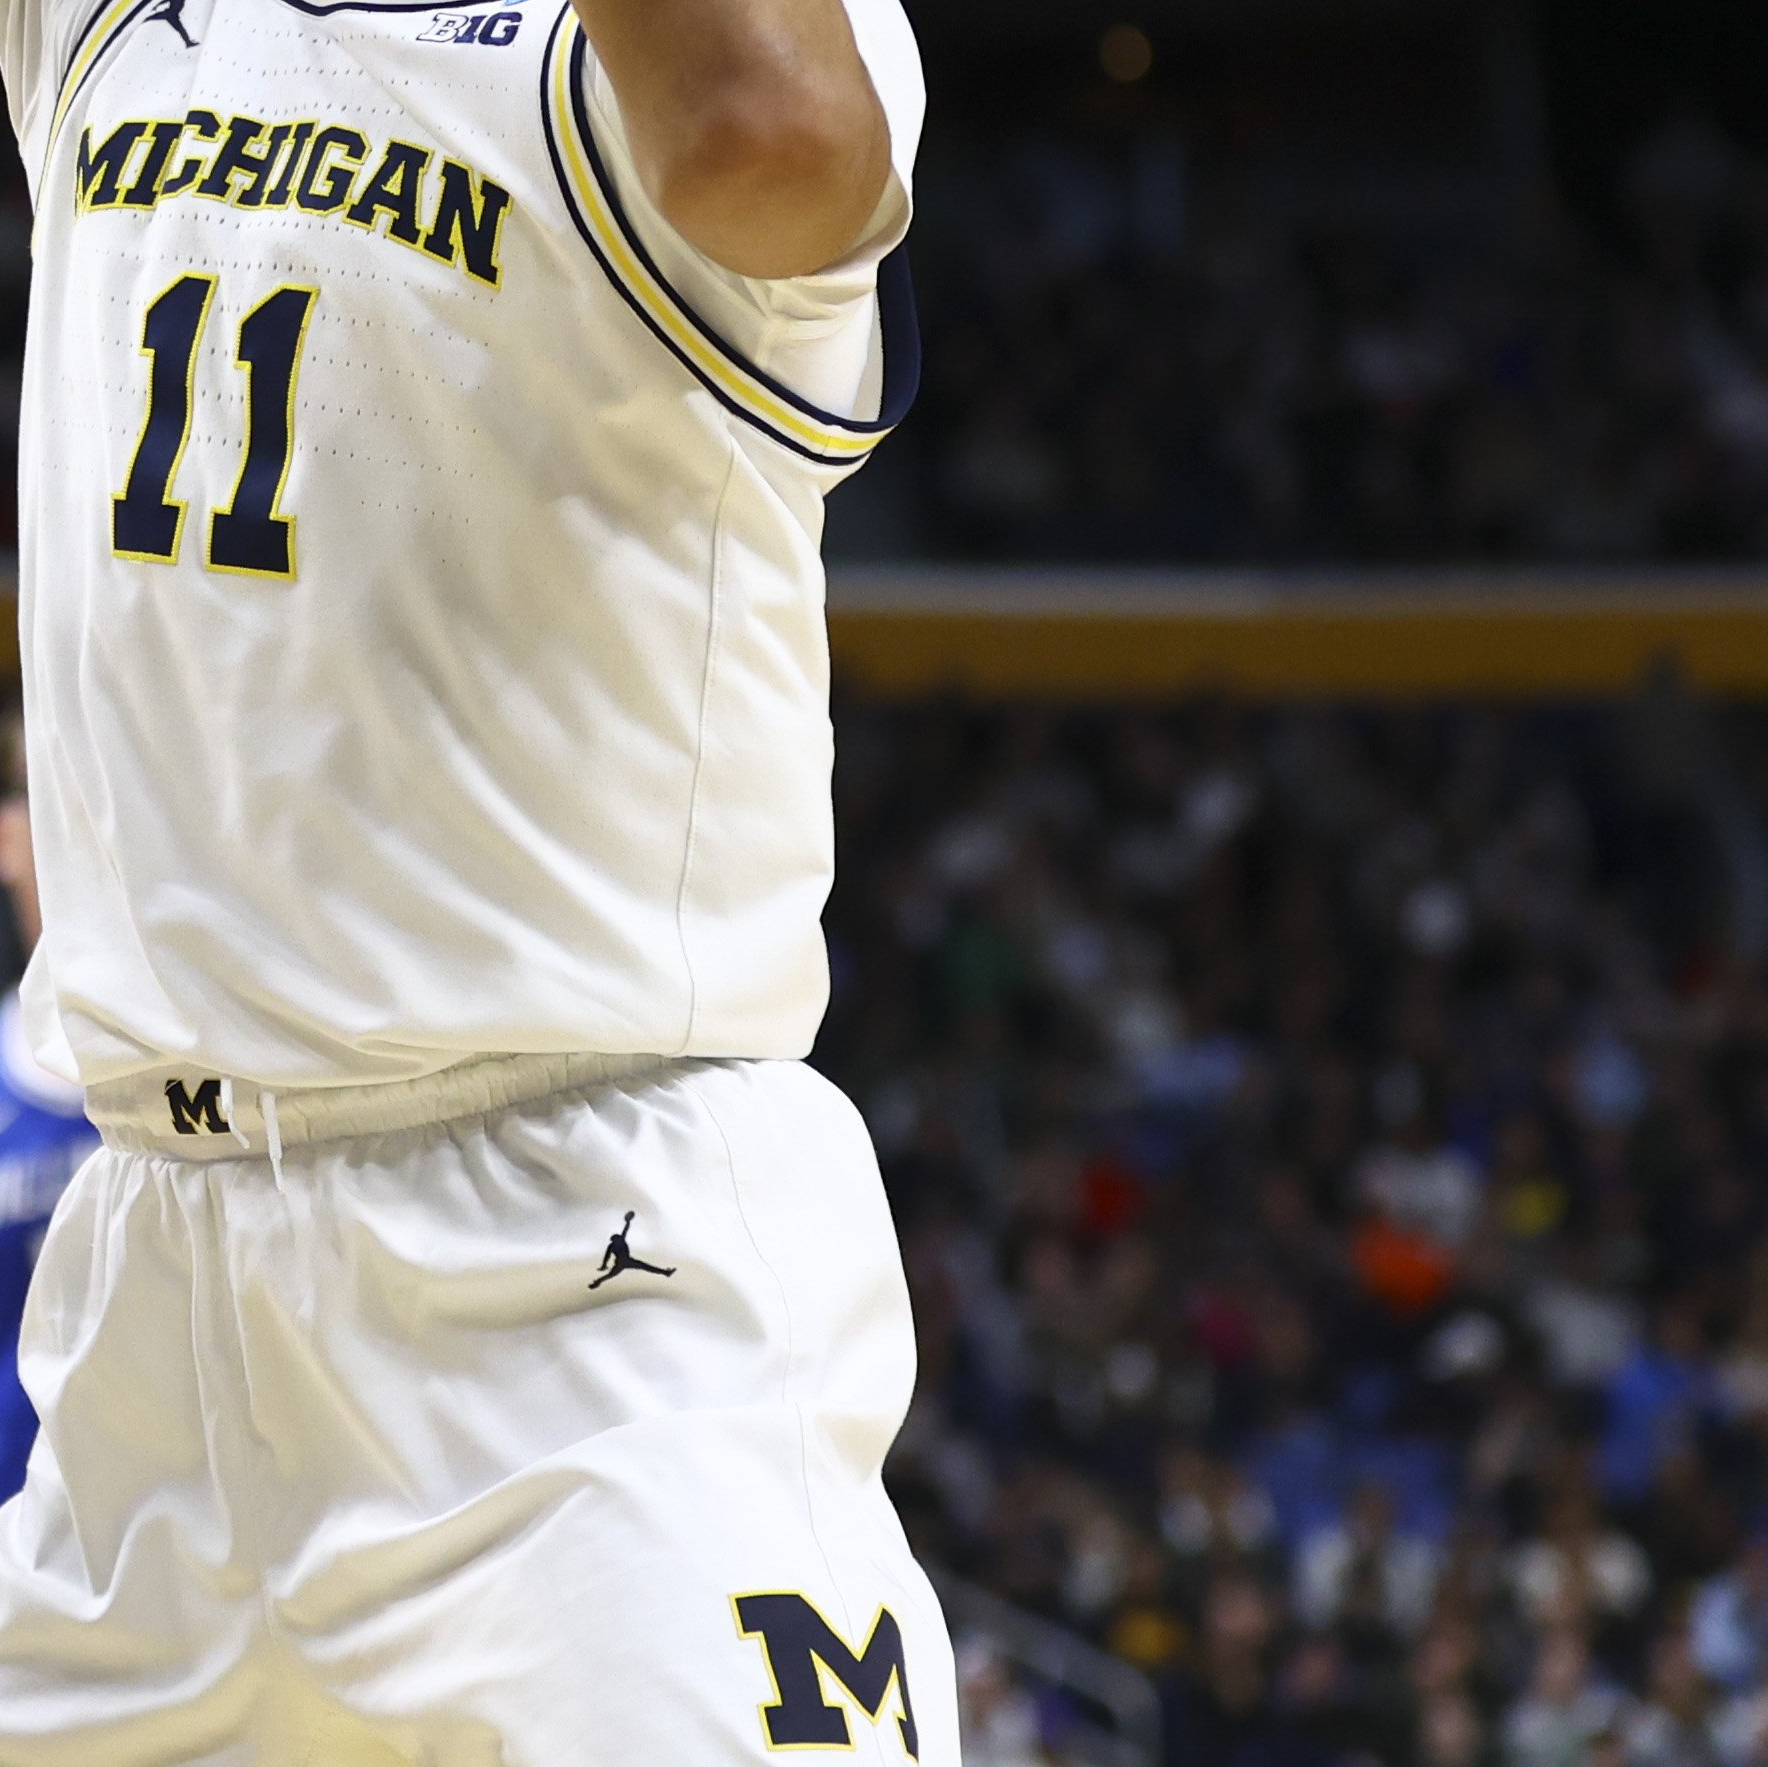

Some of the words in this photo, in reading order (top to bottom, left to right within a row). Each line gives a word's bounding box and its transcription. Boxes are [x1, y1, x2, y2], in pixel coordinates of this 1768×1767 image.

[74, 107, 515, 291] MICHIGAN
[110, 269, 322, 581] 11
[164, 1078, 232, 1135] M
[726, 1588, 921, 1764] M
